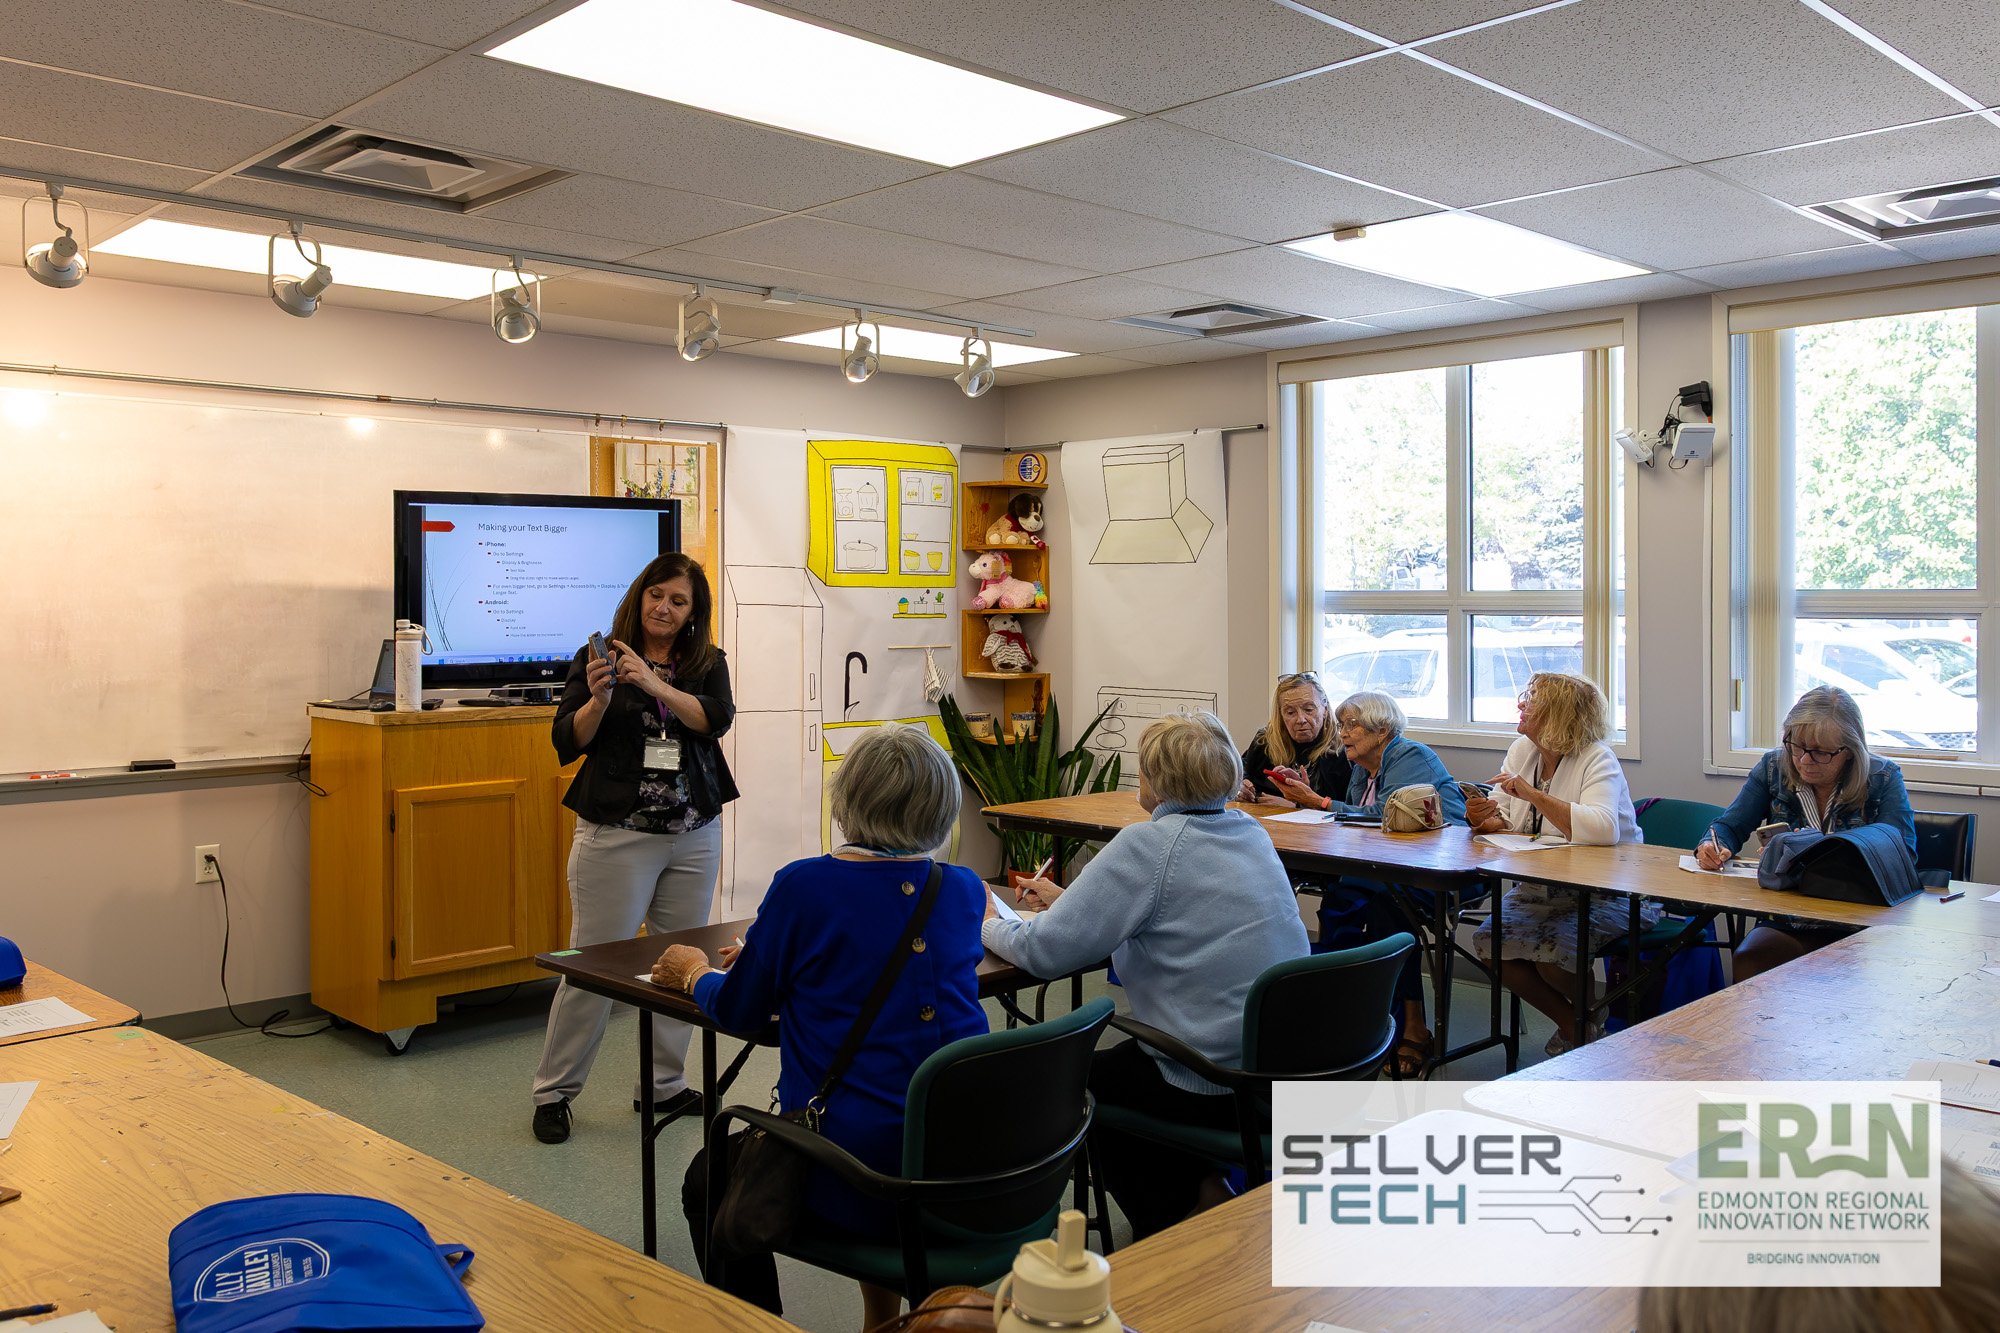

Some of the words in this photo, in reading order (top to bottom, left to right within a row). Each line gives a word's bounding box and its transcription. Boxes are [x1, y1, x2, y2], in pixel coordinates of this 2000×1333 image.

[478, 523, 507, 533] Making
[508, 525, 525, 533] your
[527, 524, 542, 532] Text
[544, 524, 568, 533] Bigger
